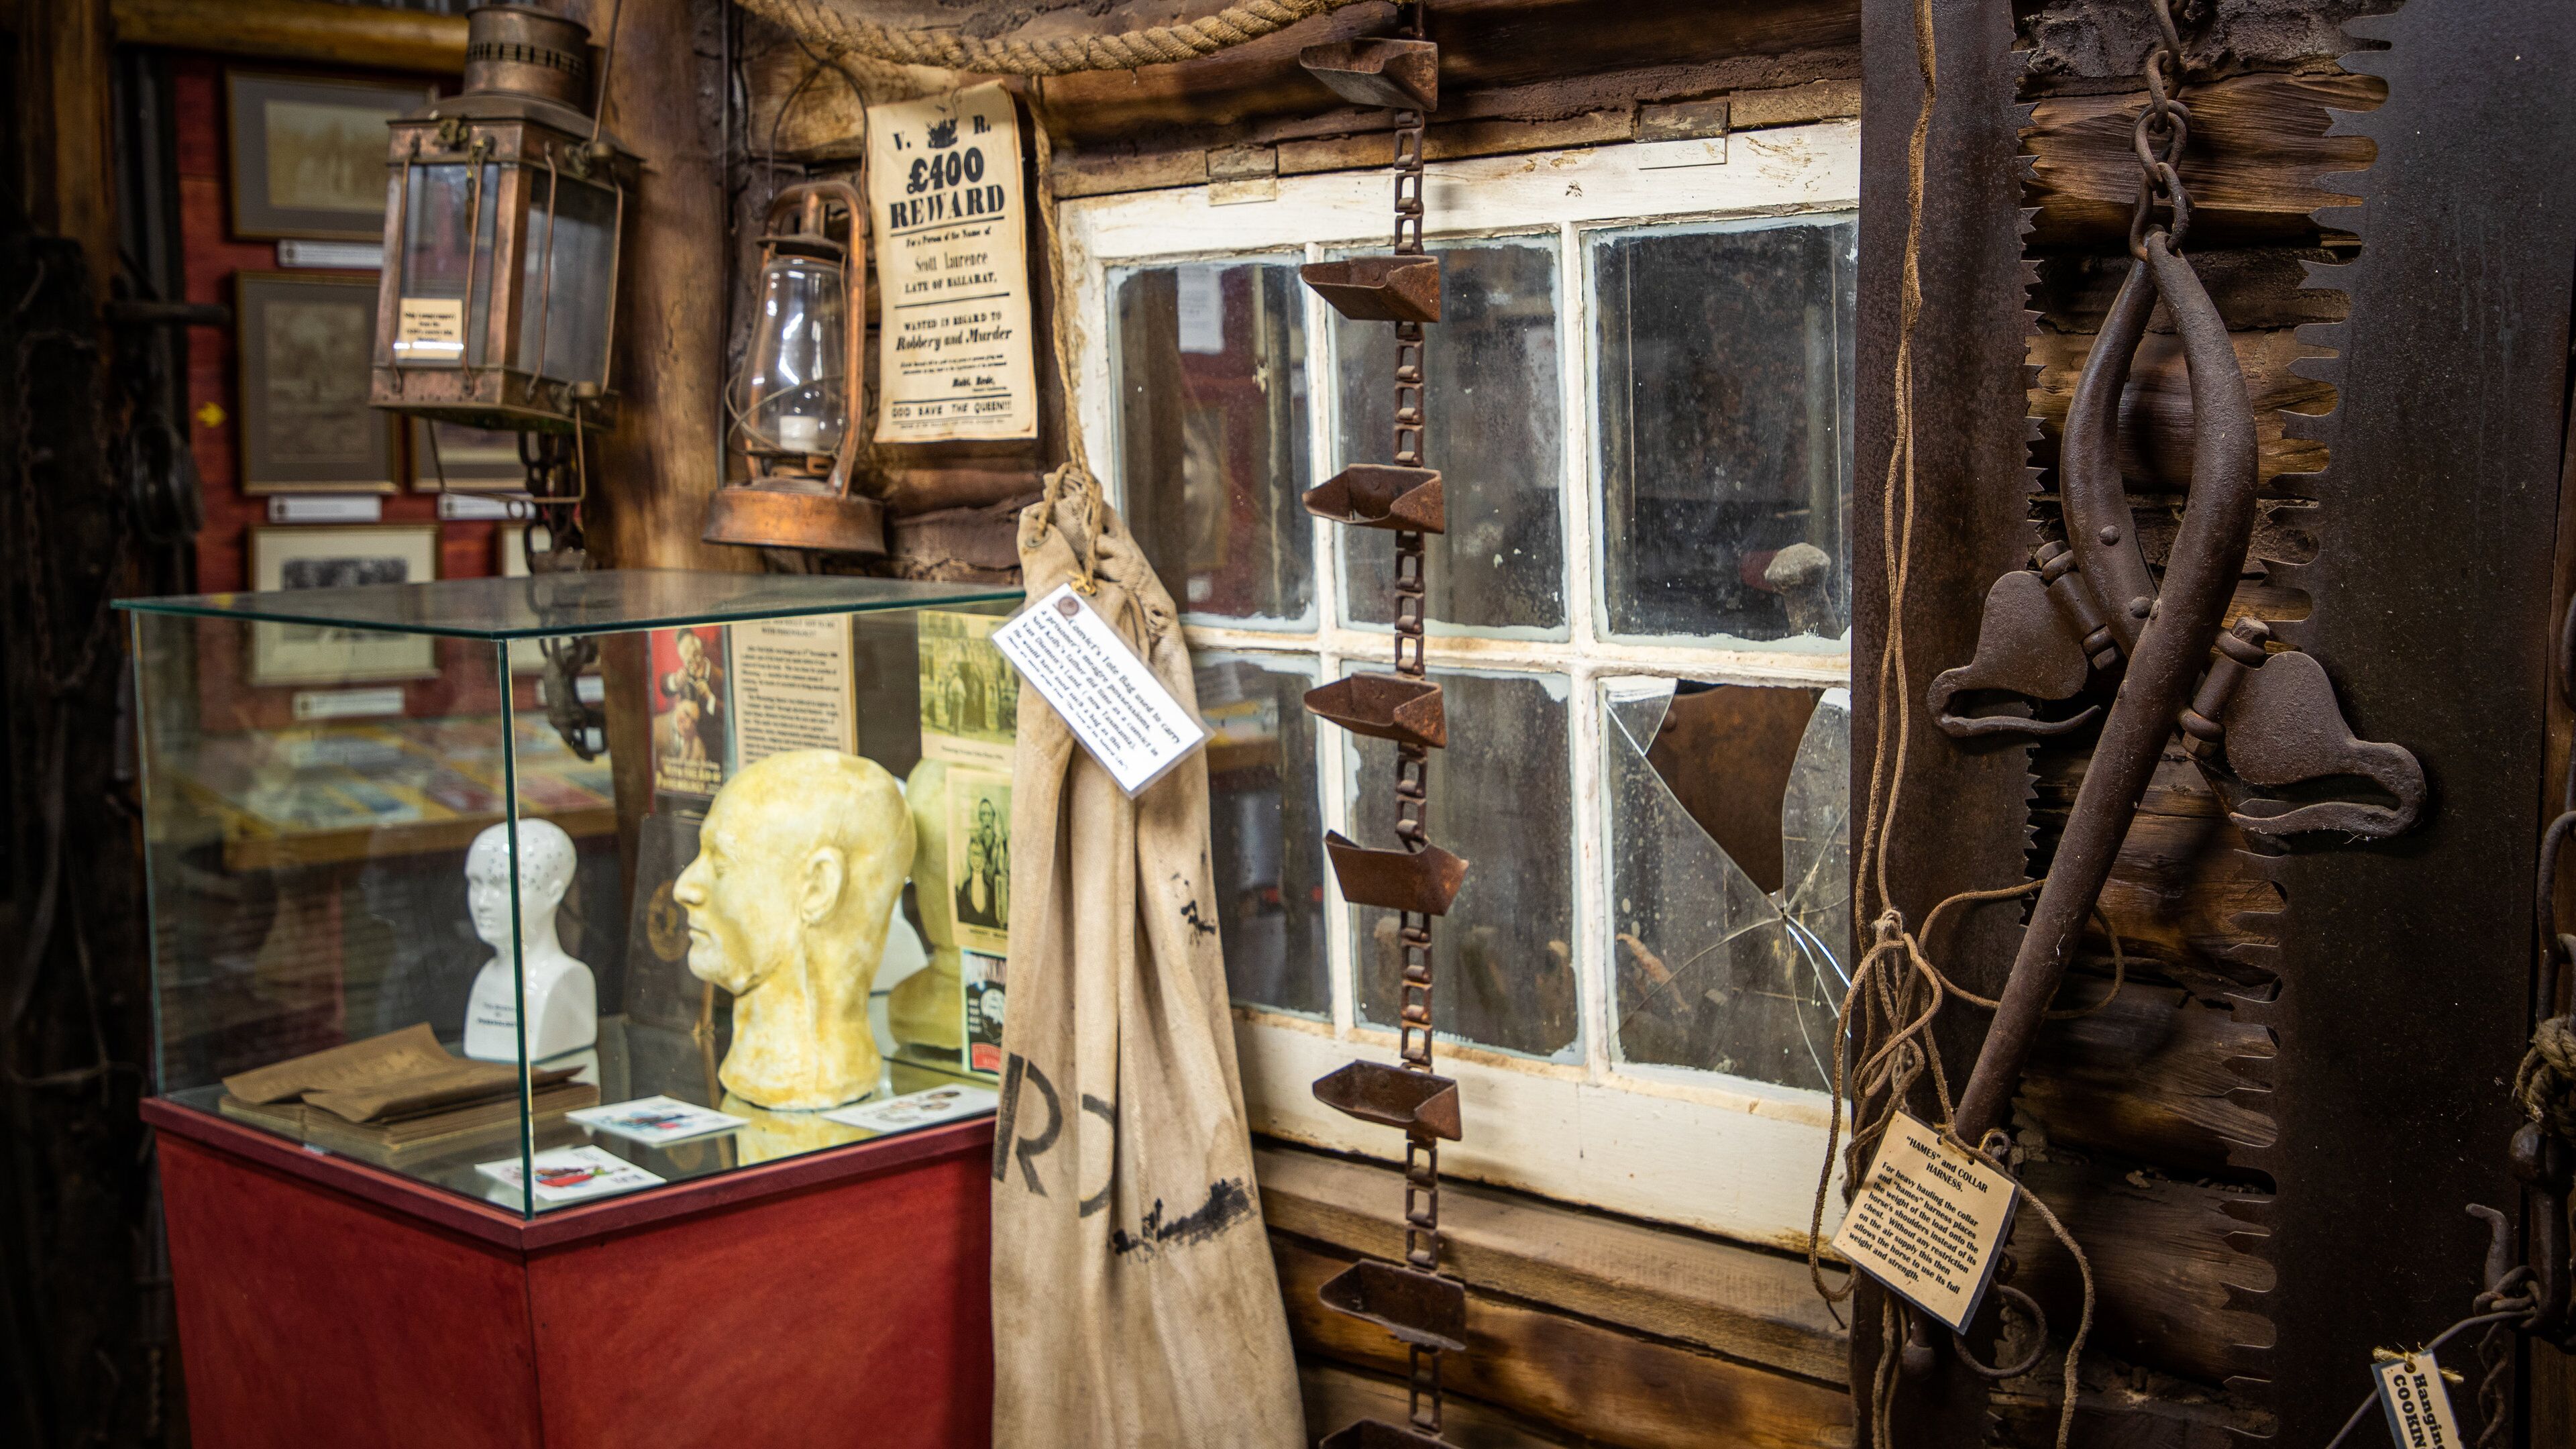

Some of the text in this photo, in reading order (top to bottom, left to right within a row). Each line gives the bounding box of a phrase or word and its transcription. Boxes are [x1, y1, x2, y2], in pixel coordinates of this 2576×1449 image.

[892, 114, 991, 151] V. R.
[906, 146, 984, 195] £400
[890, 184, 1005, 229] REWARD
[904, 271, 998, 294] LATE OF BALLARAT,
[895, 324, 1013, 352] Robbery and Murder
[903, 319, 938, 331] WANTED
[990, 310, 1002, 321] TO
[891, 406, 912, 419] GOD
[918, 405, 943, 416] SAVE
[951, 402, 969, 413] THE
[1067, 619, 1102, 657] Convict's
[1101, 655, 1120, 676] Tote
[1118, 674, 1136, 695] Bag
[1134, 693, 1155, 713] used
[1160, 722, 1181, 744] carry
[1881, 1161, 1979, 1227] For heavy hauling the collar
[1906, 1134, 1988, 1194] "HAMES" and COLLAR
[1925, 1161, 1963, 1193] HARNESS.
[1868, 1190, 1977, 1266] horse's shoulders instead of its
[1872, 1181, 1979, 1254] the weight of the load onto the
[1876, 1173, 1977, 1240] and "hames" harness places
[1848, 1231, 1919, 1283] weight and strength.
[1852, 1222, 1961, 1295] allows the horse to use its full
[1858, 1212, 1951, 1276] on the air supply this then
[1863, 1202, 1970, 1274] chest. Without any restriction
[2394, 1374, 2427, 1449] COOKIN
